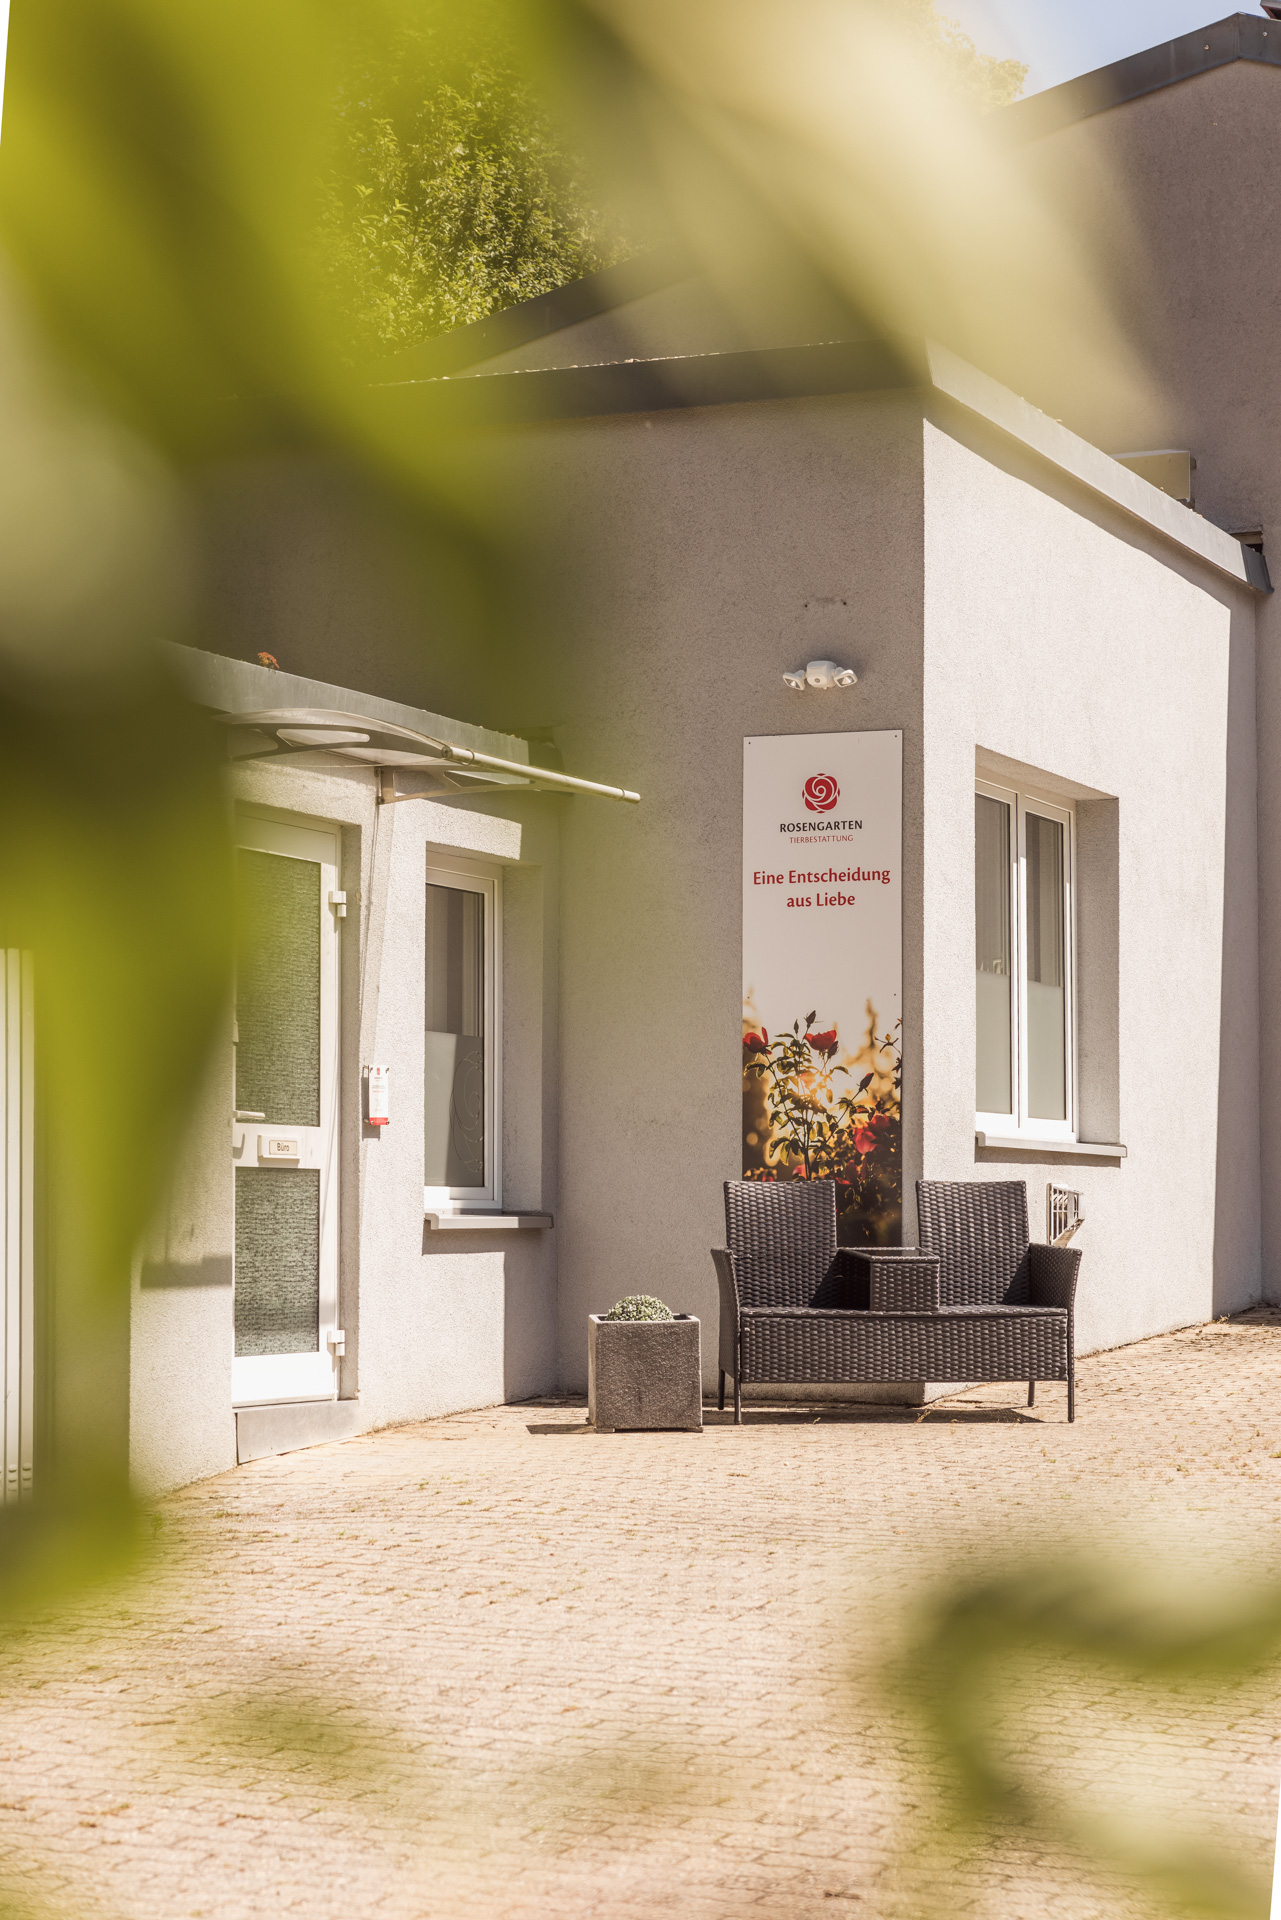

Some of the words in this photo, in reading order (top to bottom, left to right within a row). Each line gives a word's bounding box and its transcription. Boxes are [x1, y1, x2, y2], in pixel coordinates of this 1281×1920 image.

[779, 820, 863, 832] ROSENGARTEN
[789, 834, 854, 844] TIERBESTATTUNG
[753, 871, 784, 885] Eine
[788, 867, 891, 885] Entscheidung
[786, 896, 812, 908] aus
[816, 891, 856, 907] Liebe
[277, 1142, 290, 1151] Büro
